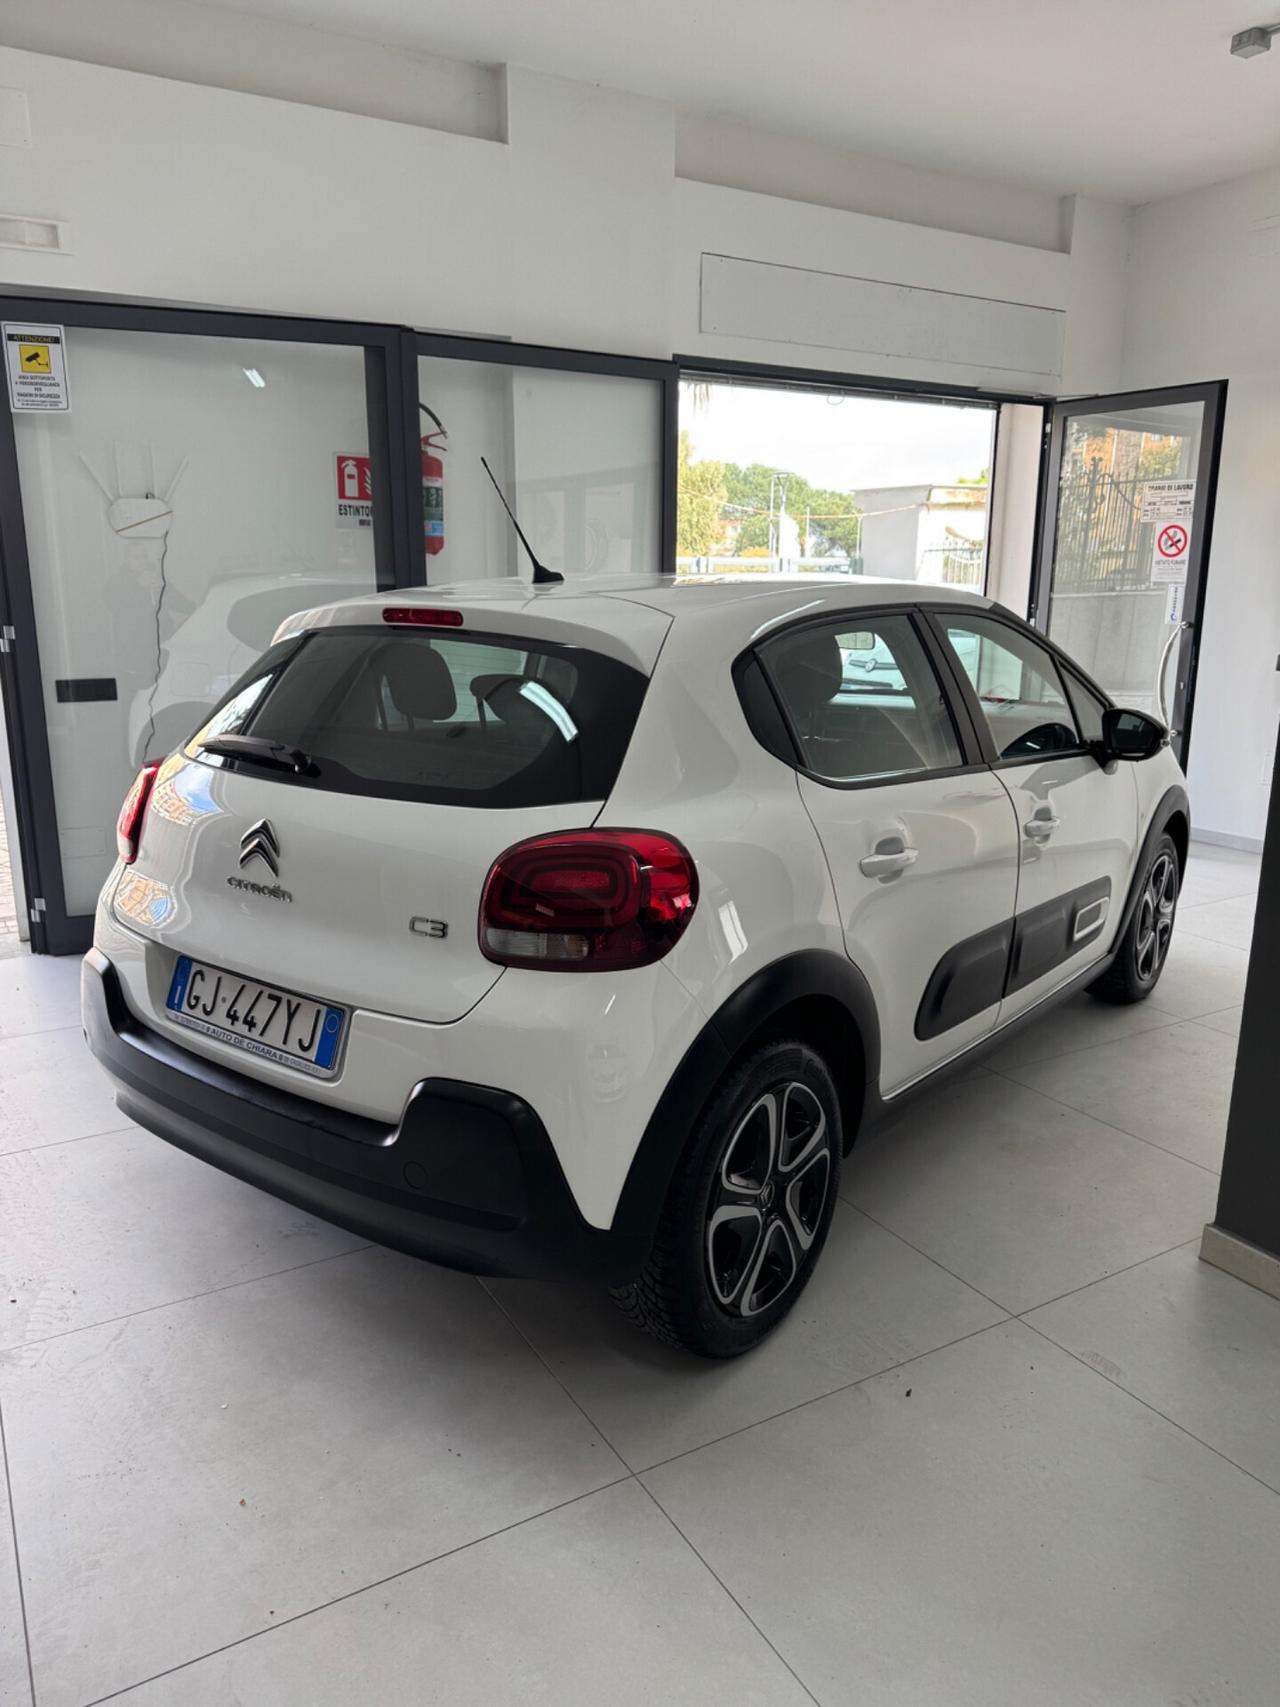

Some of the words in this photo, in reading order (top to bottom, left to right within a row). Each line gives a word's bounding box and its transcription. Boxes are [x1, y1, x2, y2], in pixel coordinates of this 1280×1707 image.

[338, 504, 372, 517] ESTINTO
[409, 916, 448, 938] C3
[210, 1028, 233, 1041] AUTO
[233, 1036, 245, 1046] DE
[246, 1041, 278, 1059] CHIARA
